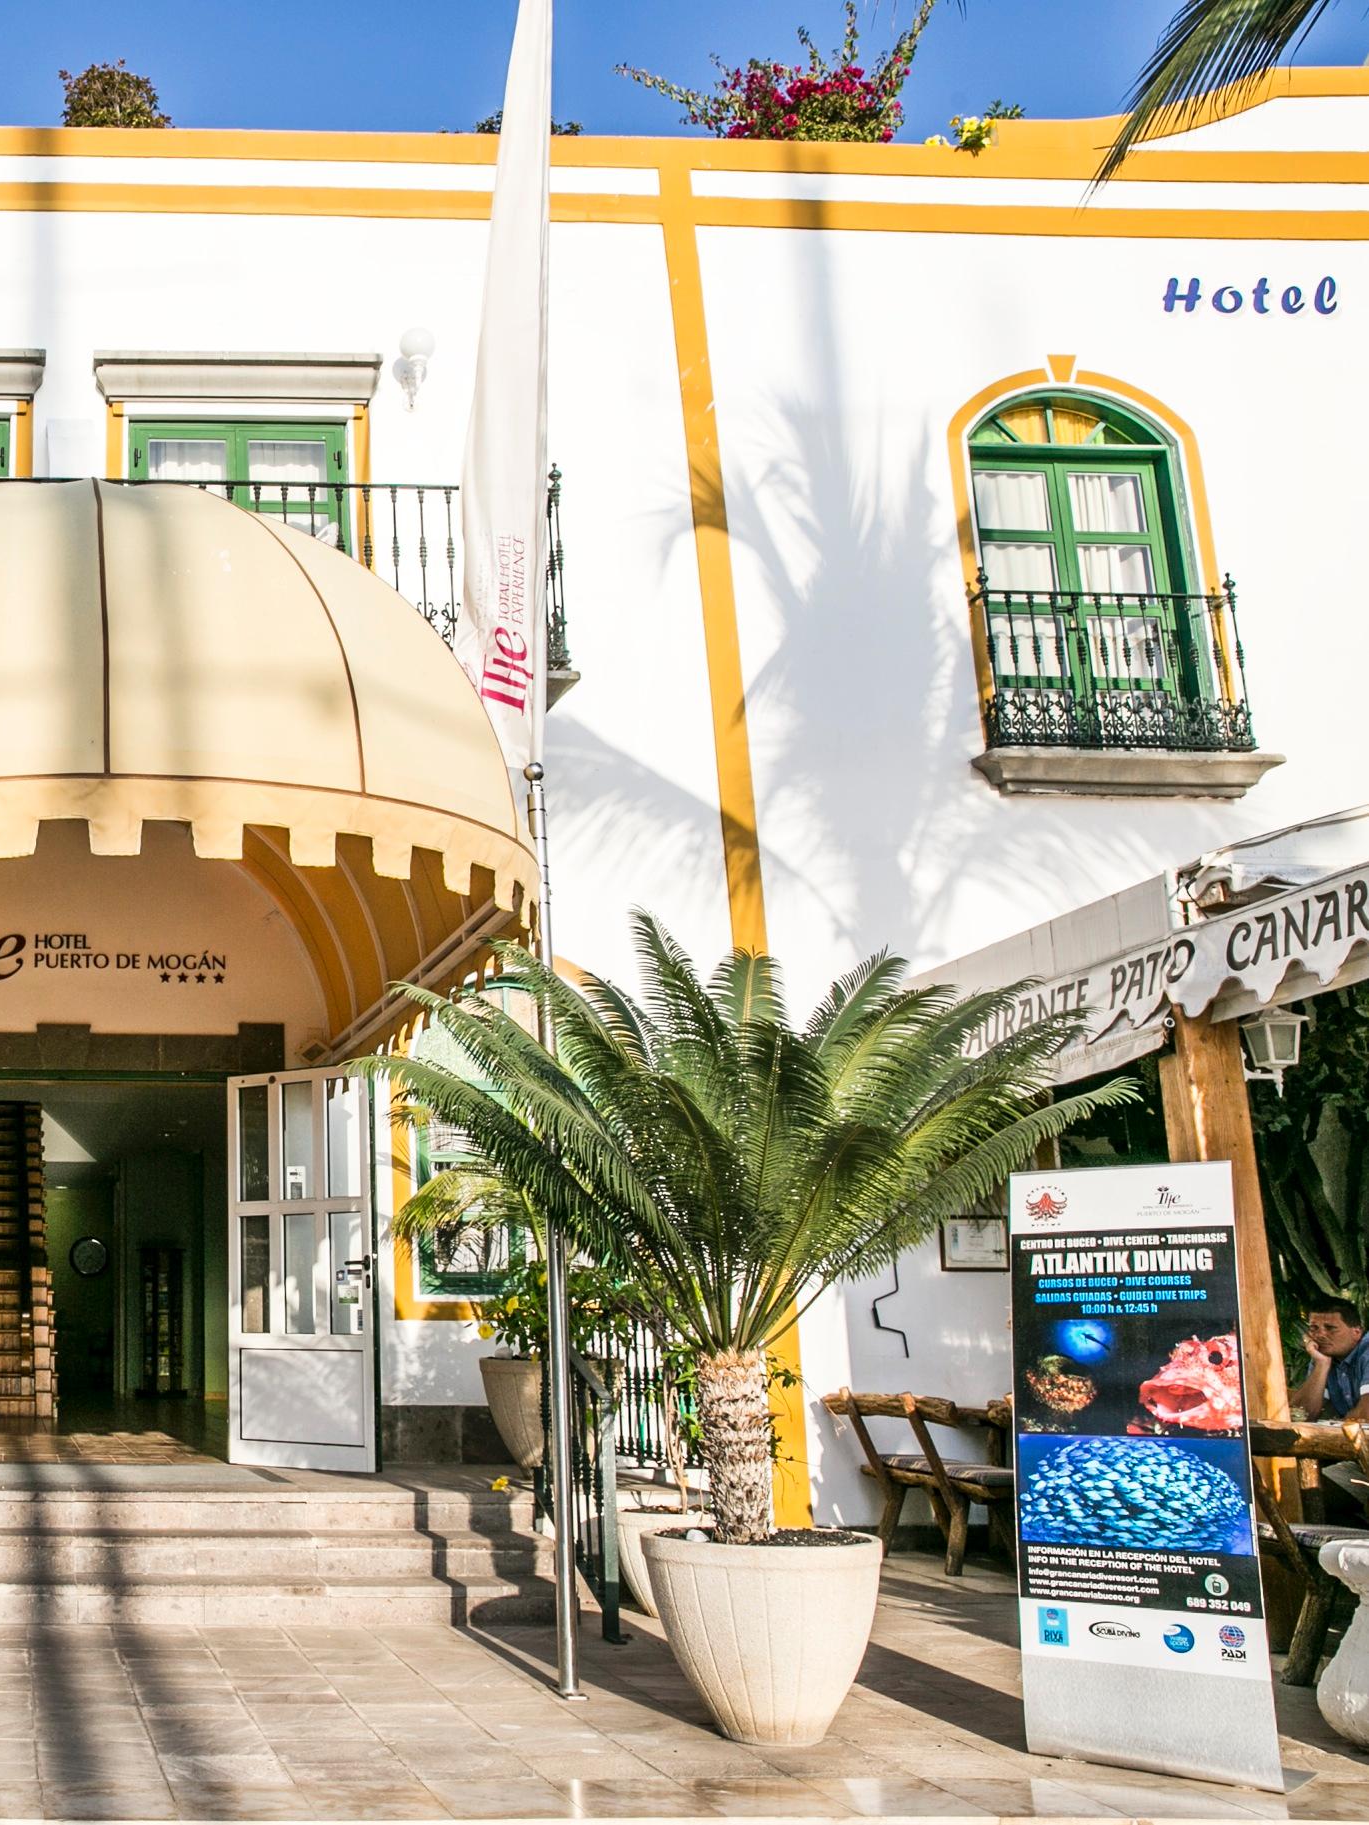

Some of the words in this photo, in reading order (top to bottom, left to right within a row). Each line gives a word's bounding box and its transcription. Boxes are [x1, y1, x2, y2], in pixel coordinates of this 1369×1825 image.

[1163, 276, 1338, 315] Hotel
[498, 533, 511, 577] HOTEL
[511, 534, 525, 625] EXPERIENCE
[498, 579, 510, 621] TOTAL
[34, 933, 92, 951] HOTEL
[34, 952, 110, 970] PUERTO
[115, 953, 141, 970] DE
[146, 950, 227, 971] MOGÁN
[1020, 1239, 1053, 1250] CENTRO
[1054, 1238, 1066, 1249] DE
[1066, 1237, 1097, 1248] BUCEO
[1103, 1235, 1125, 1247] DIVE
[1125, 1235, 1160, 1245] CENTER
[1166, 1233, 1228, 1244] TAUCHBASIS
[1030, 1251, 1130, 1275] ATLANTIK
[1134, 1248, 1214, 1272] DIVING
[1038, 1278, 1074, 1289] CURSOS
[1075, 1278, 1087, 1288] DE
[1088, 1277, 1118, 1287] BUCEO
[1125, 1276, 1147, 1286] DIVE
[1148, 1275, 1192, 1286] COURSES
[1034, 1292, 1072, 1304] SALIDAS
[1073, 1291, 1112, 1302] GUIADAS
[1119, 1290, 1154, 1301] GUIDED
[1155, 1290, 1177, 1300] DIVE
[1178, 1289, 1207, 1300] TRIPS
[1081, 1304, 1106, 1315] 10:00
[1107, 1304, 1114, 1314] h
[1124, 1303, 1149, 1314] 12:45
[1150, 1303, 1158, 1313] h
[1027, 1545, 1087, 1558] INFORMACIÓN
[1088, 1549, 1101, 1558] EN
[1102, 1550, 1114, 1560] LA
[1115, 1551, 1168, 1563] RECEPCIÓN
[1169, 1555, 1187, 1564] DEL
[1188, 1556, 1221, 1567] HOTEL
[1028, 1555, 1048, 1564] INFO
[1049, 1556, 1058, 1565] IN
[1059, 1556, 1077, 1566] THE
[1078, 1558, 1129, 1570] RECEPTION
[1130, 1561, 1143, 1571] OF
[1143, 1562, 1162, 1572] THE
[1163, 1564, 1195, 1575] HOTEL
[1186, 1597, 1207, 1608] 689
[1208, 1599, 1229, 1610] 352
[1230, 1600, 1251, 1612] 049
